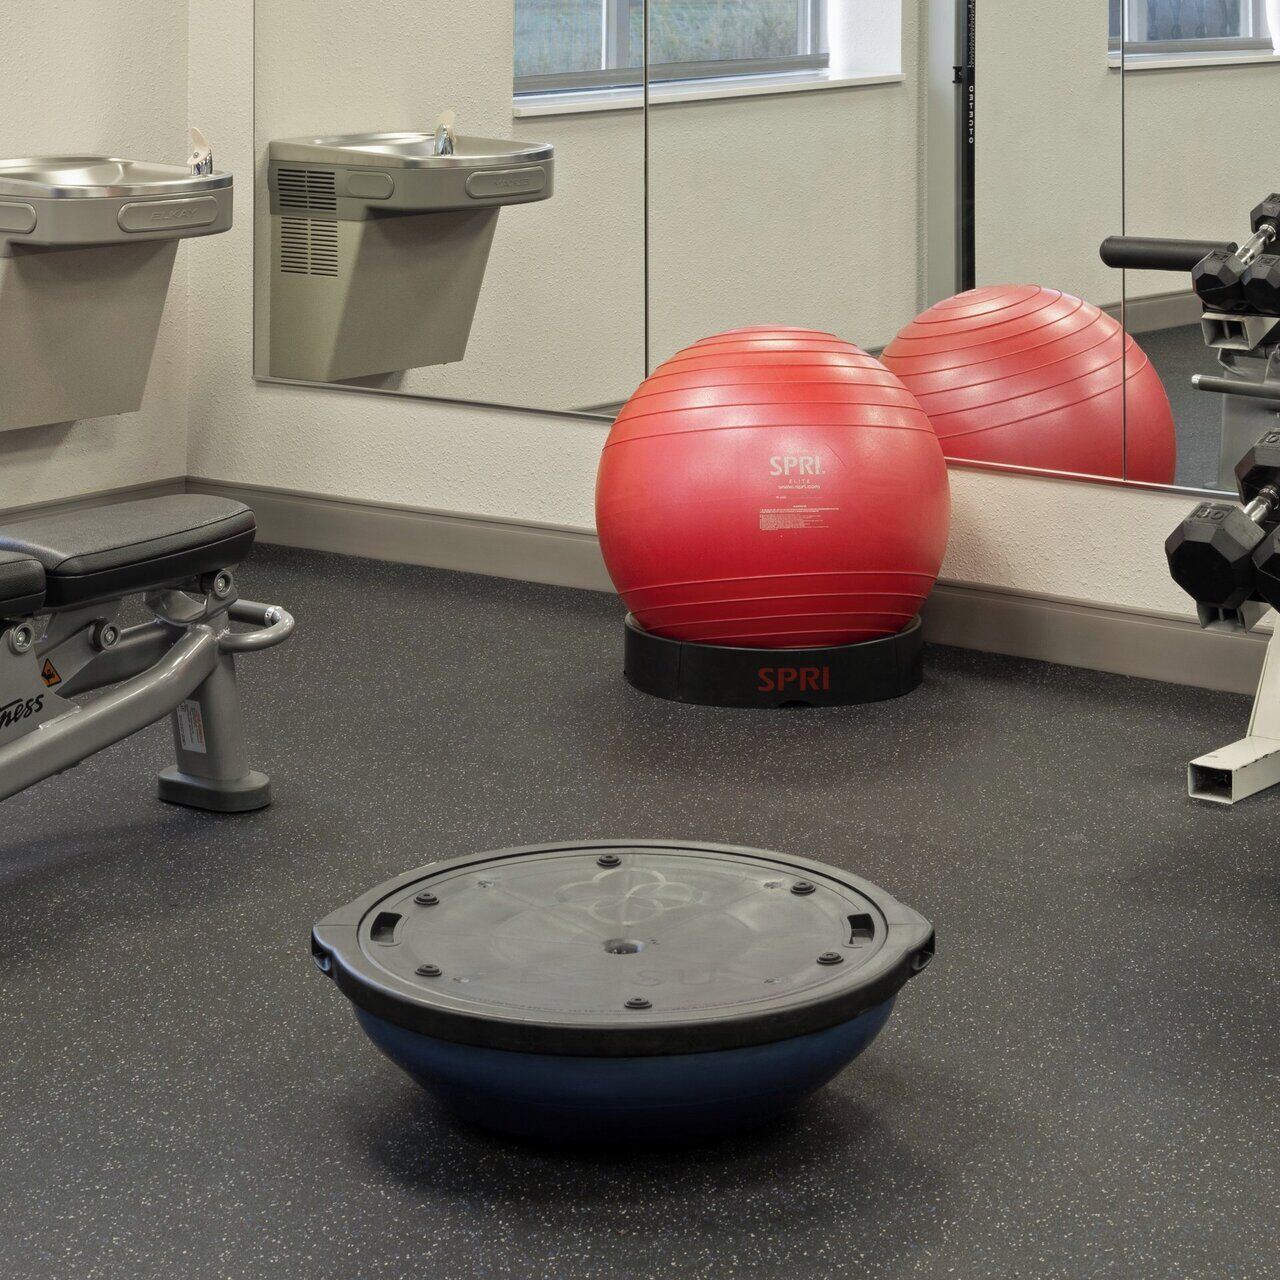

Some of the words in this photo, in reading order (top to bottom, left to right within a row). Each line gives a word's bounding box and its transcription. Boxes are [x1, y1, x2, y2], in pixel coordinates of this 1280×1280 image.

[151, 207, 199, 221] ELKAY
[768, 454, 825, 477] SPRI
[1195, 505, 1225, 521] 30
[757, 666, 830, 692] SPRI
